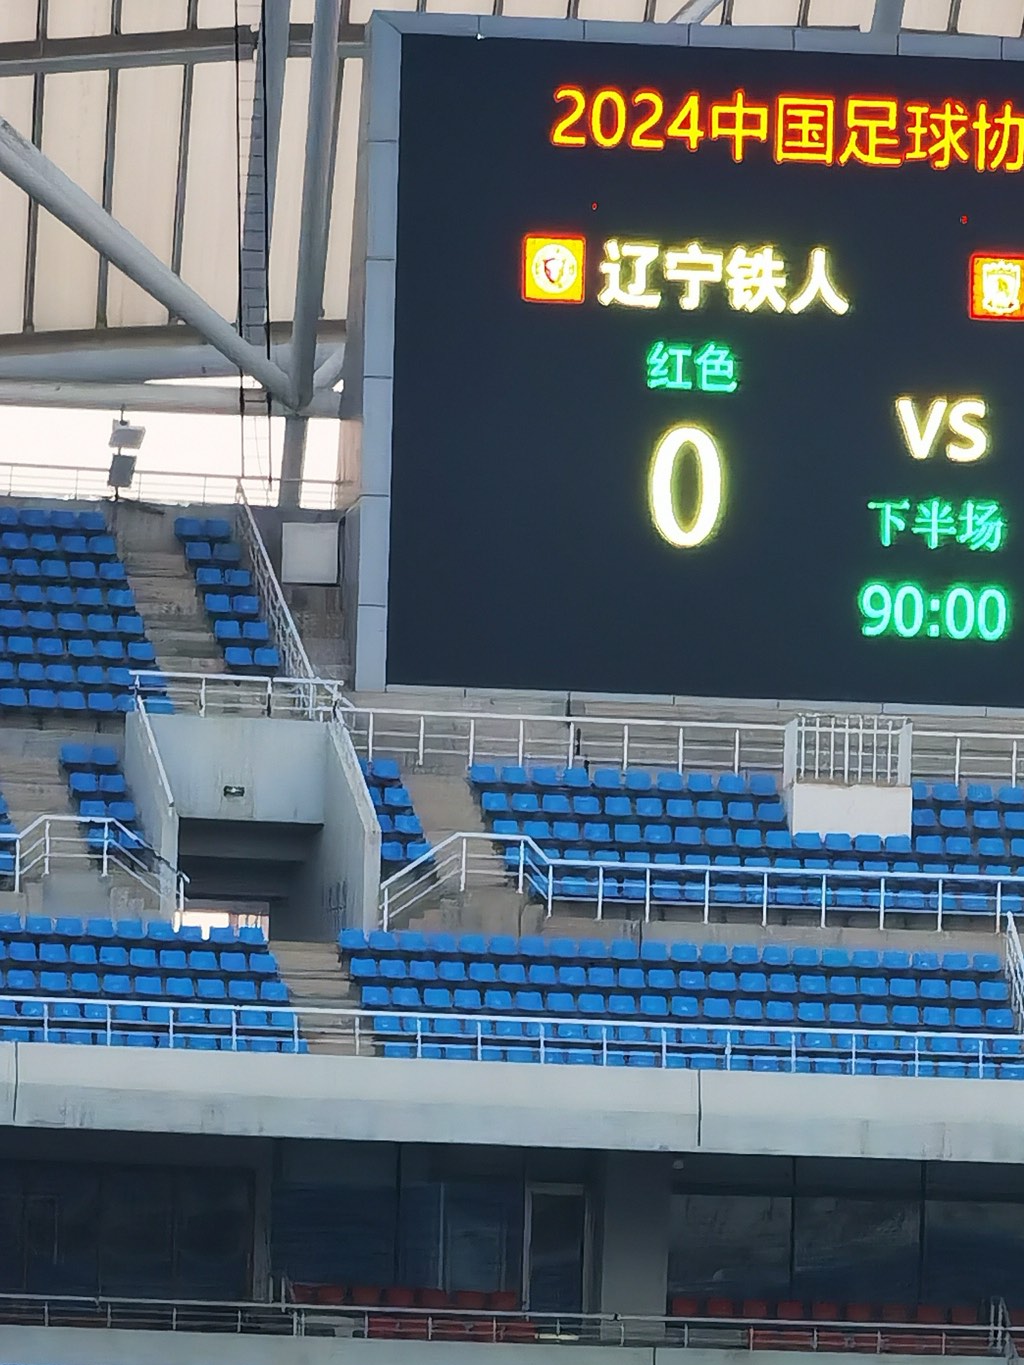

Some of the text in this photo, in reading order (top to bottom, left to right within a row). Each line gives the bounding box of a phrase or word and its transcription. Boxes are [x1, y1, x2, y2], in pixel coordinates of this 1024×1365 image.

[597, 239, 850, 315] 辽宁铁人
[646, 341, 738, 393] 红色
[895, 397, 990, 462] VS
[648, 422, 726, 548] 0
[867, 497, 1006, 551] 下半场
[858, 581, 1010, 641] 90:00
